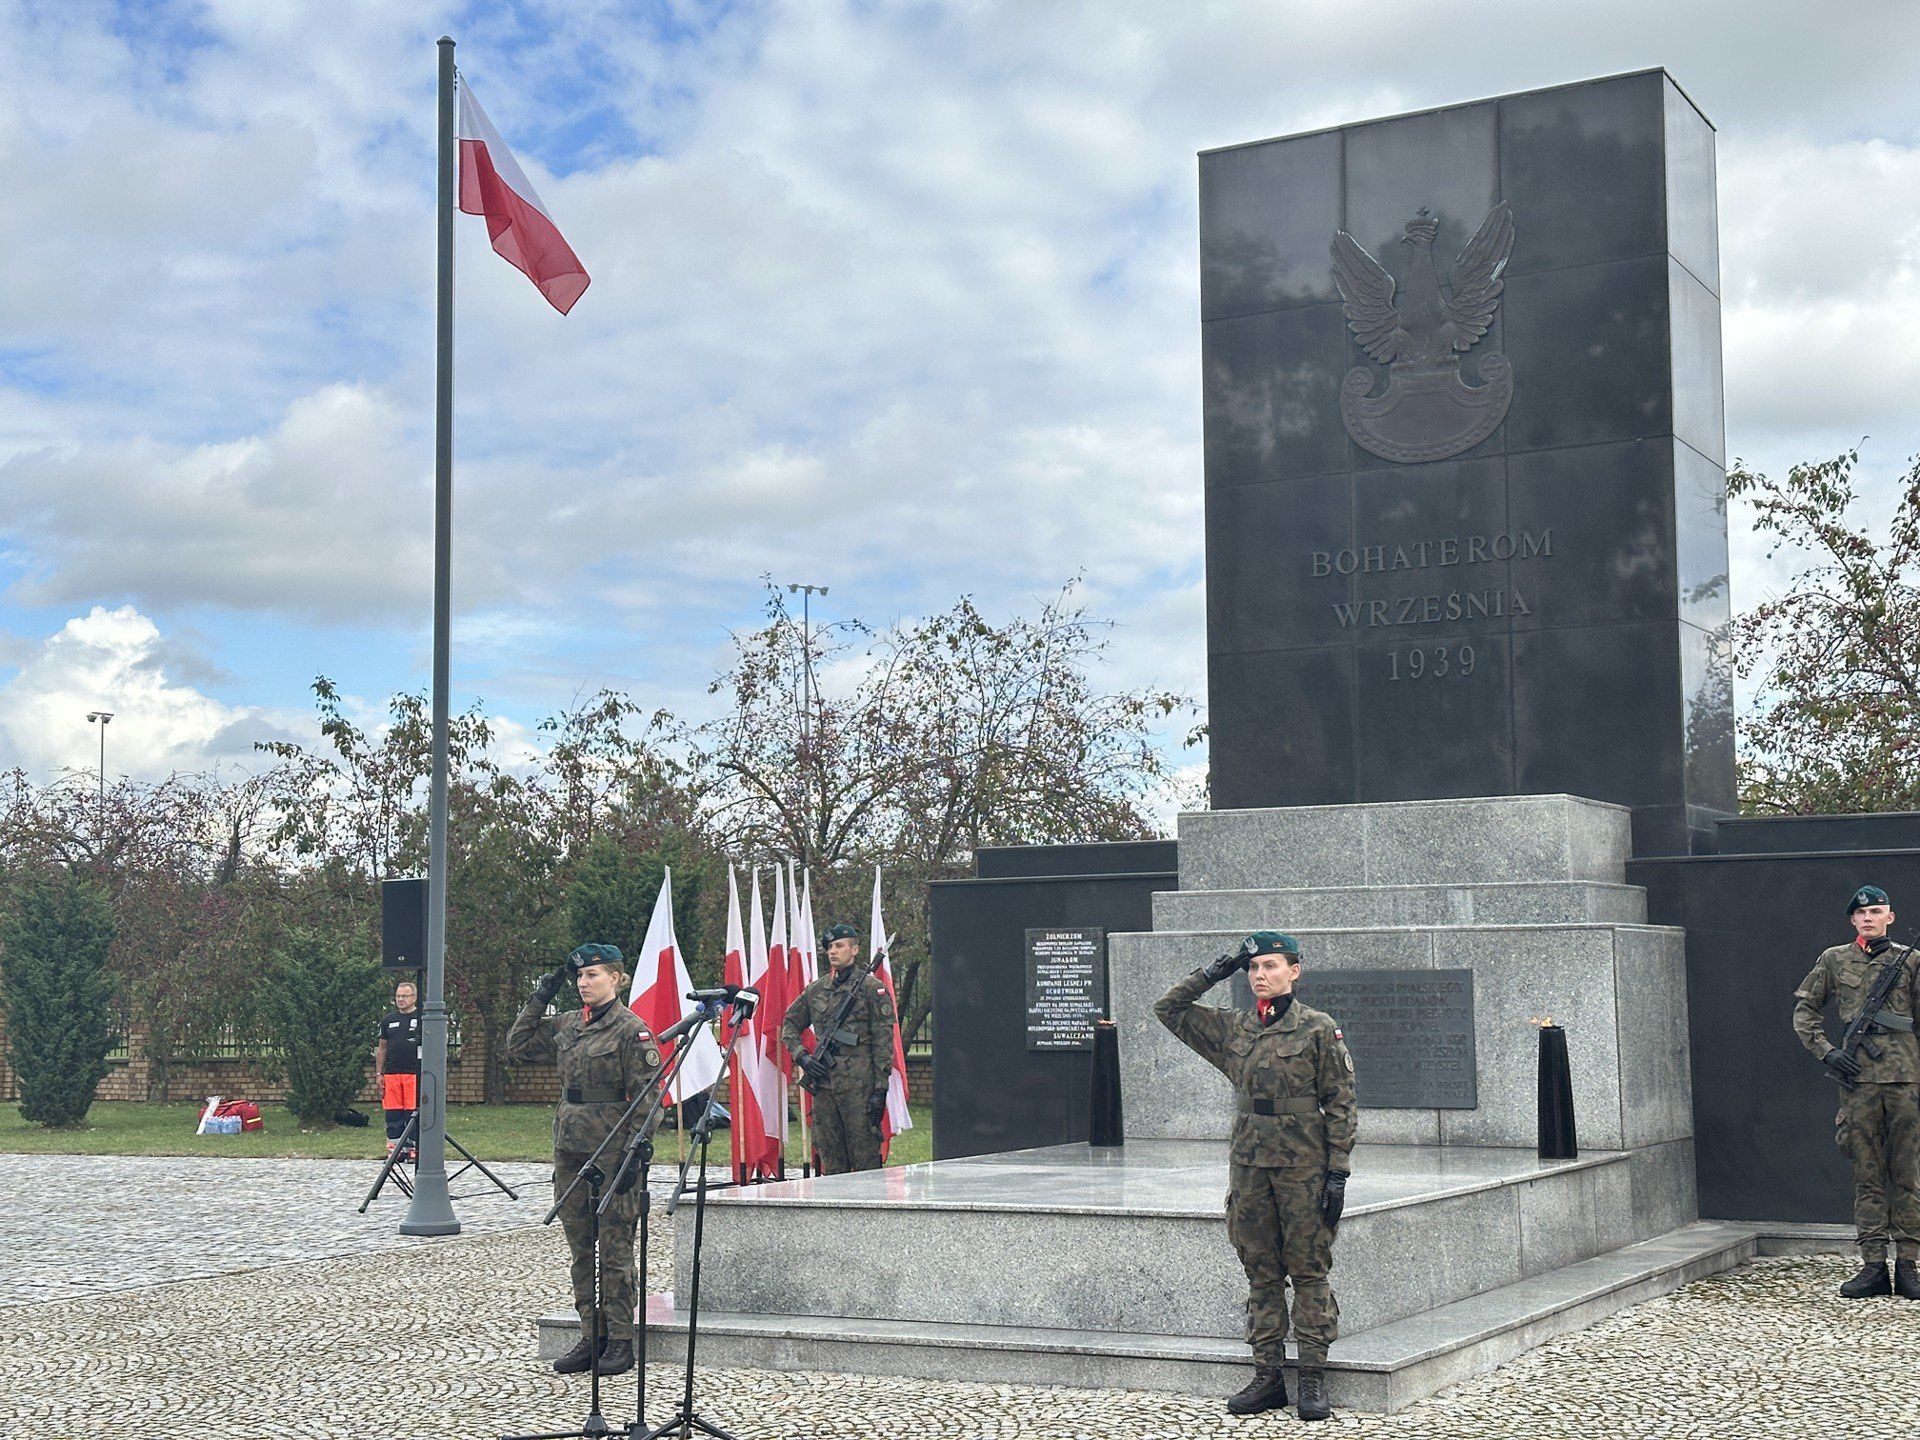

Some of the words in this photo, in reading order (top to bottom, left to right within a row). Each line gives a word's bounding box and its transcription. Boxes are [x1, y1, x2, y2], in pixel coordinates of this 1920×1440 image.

[1310, 530, 1553, 578] BOHATEROM
[1331, 586, 1532, 629] WRZEŚNIA
[1387, 645, 1476, 681] 1939
[1262, 1005, 1276, 1016] 14
